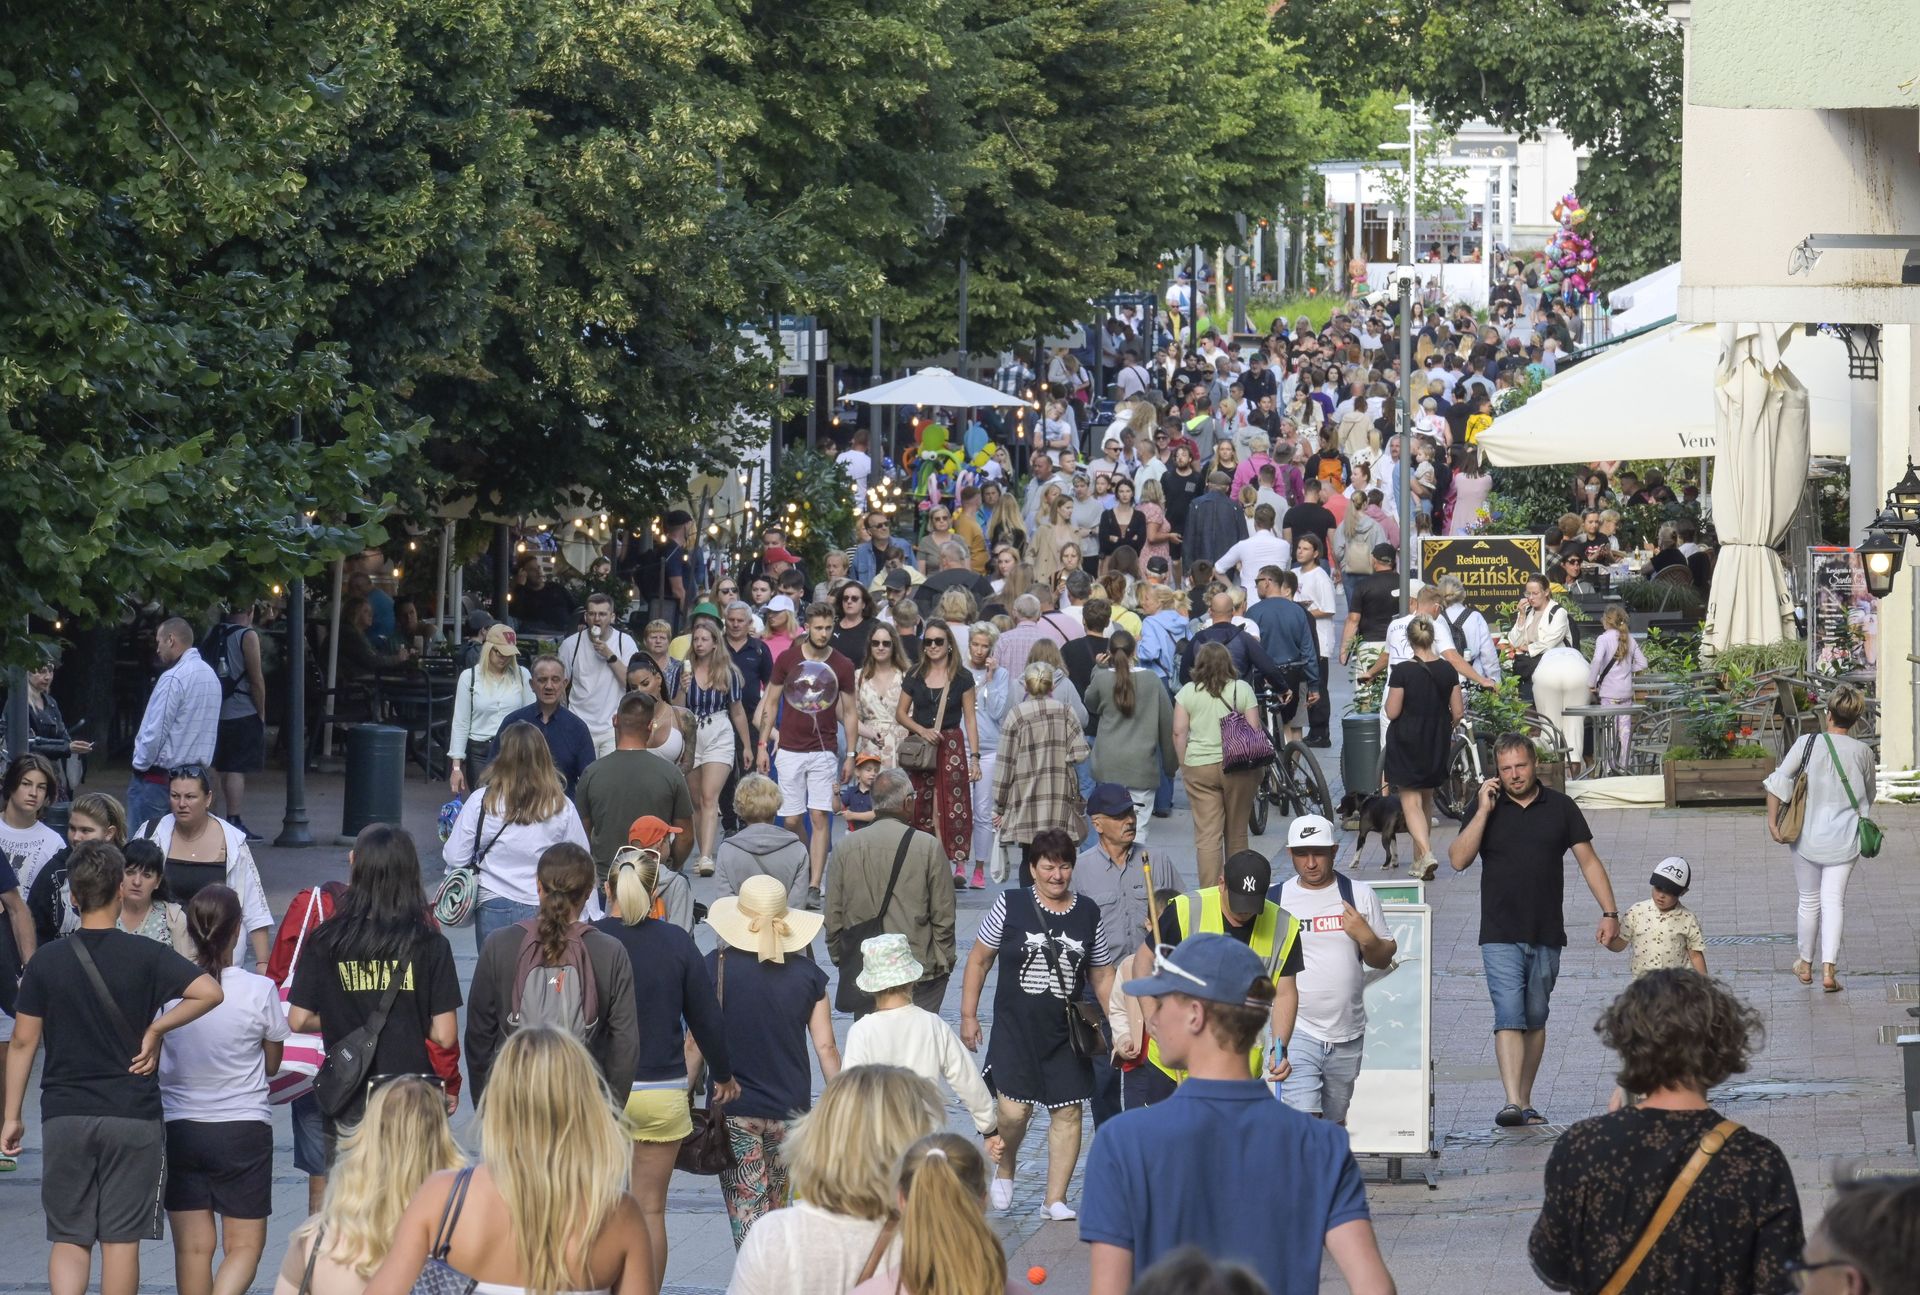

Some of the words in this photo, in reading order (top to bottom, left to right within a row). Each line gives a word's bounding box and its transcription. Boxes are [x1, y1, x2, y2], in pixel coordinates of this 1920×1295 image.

[1456, 554, 1509, 567] Restauracja
[1480, 588, 1520, 597] Restaurant
[1242, 875, 1257, 892] NY
